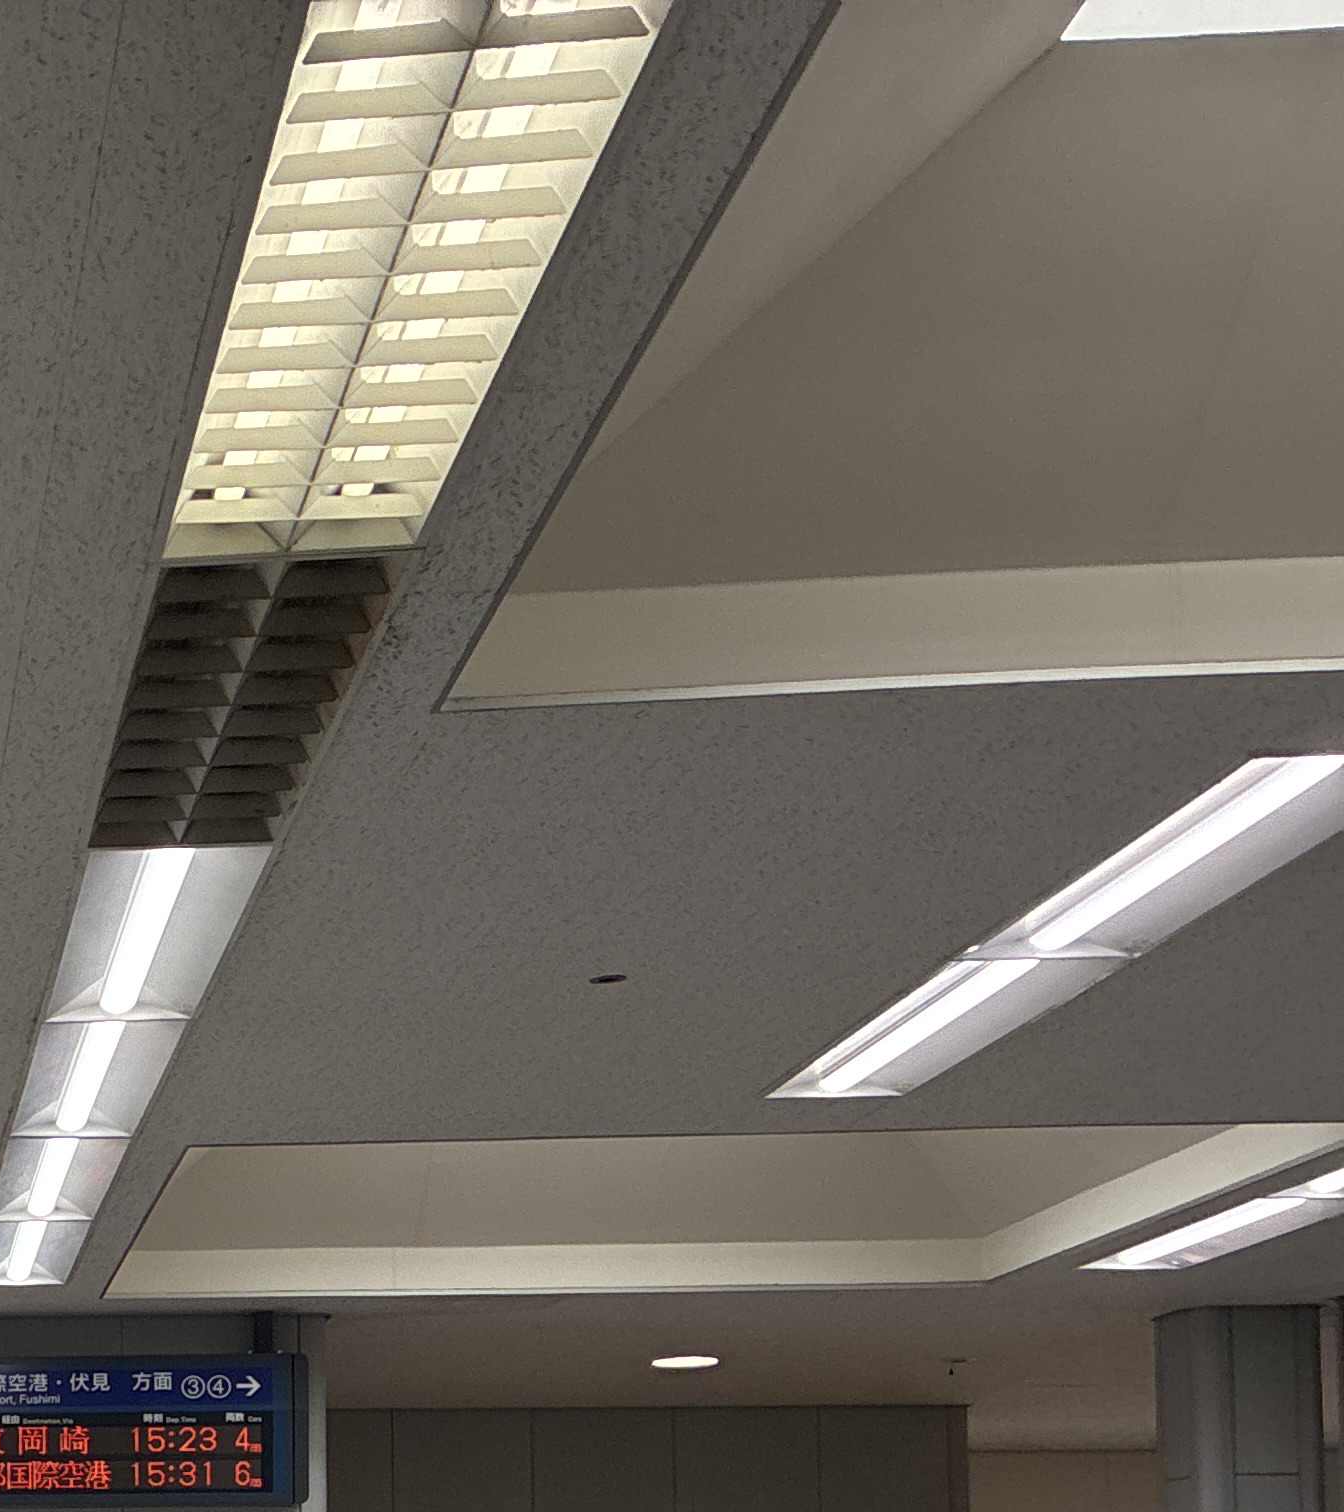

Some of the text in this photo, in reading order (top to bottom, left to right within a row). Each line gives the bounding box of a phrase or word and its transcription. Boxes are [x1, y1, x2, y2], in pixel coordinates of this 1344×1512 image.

[132, 1372, 173, 1392] 方面
[19, 1395, 61, 1406] Fushimi
[132, 1427, 217, 1452] 15:23
[132, 1461, 212, 1487] 15:31
